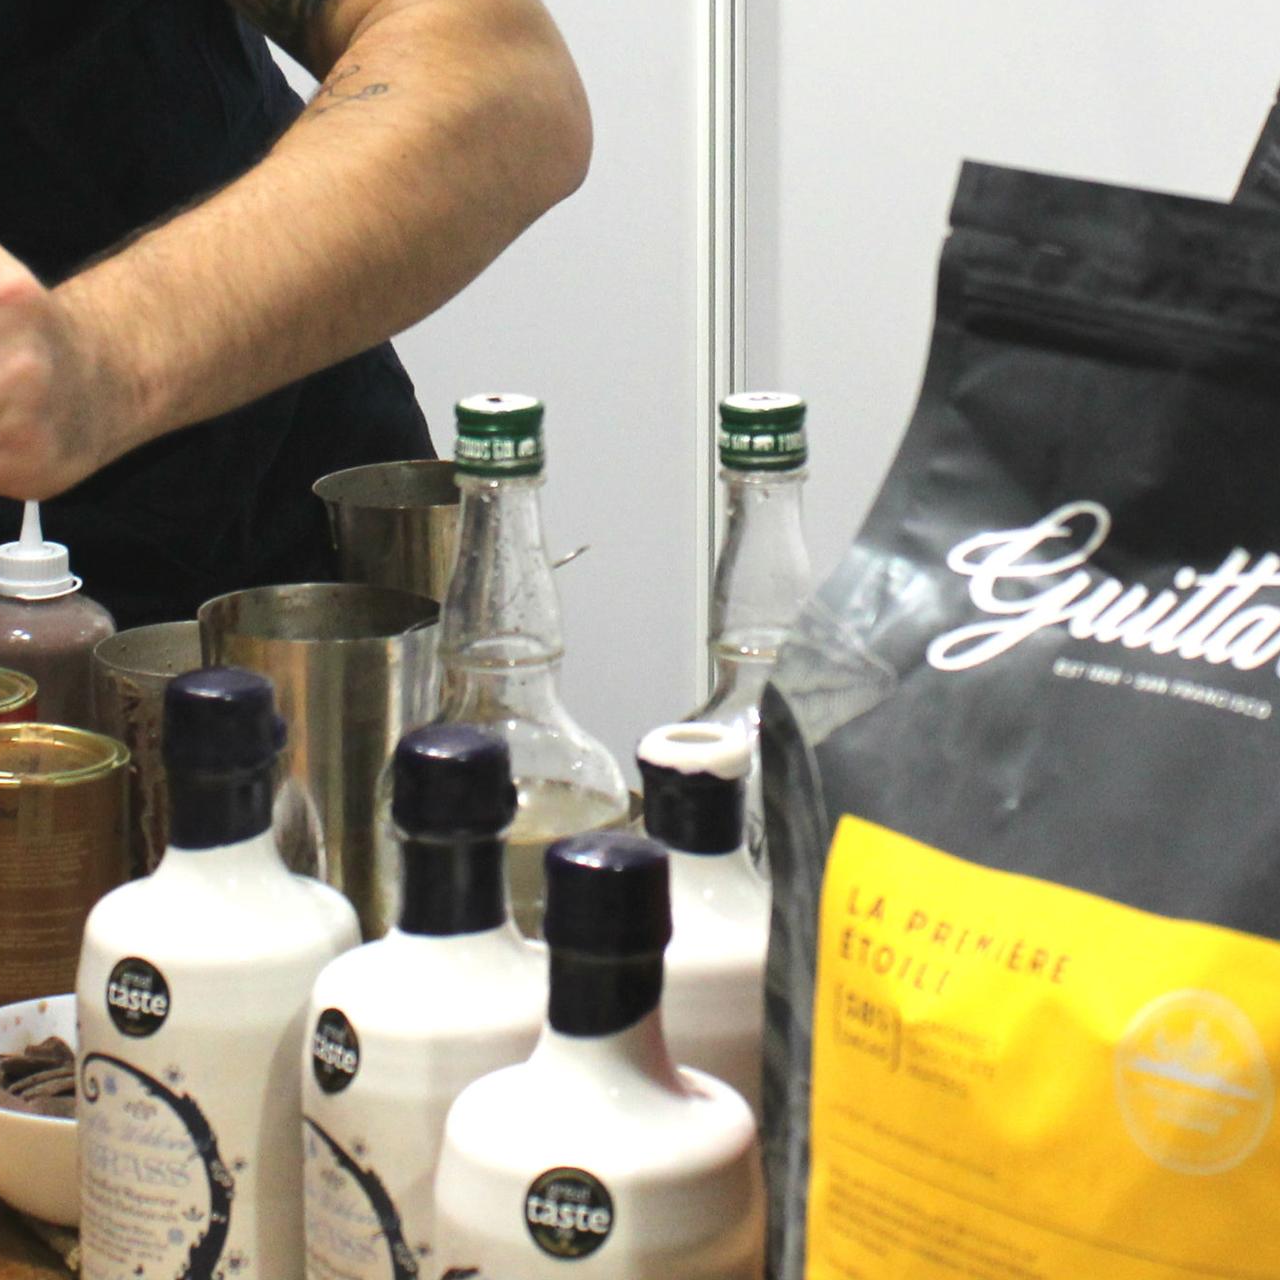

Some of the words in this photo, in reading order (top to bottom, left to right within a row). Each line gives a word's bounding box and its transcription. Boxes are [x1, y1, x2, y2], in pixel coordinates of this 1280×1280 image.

[846, 886, 886, 923] LA
[109, 982, 167, 1017] taste
[312, 1033, 357, 1073] taste
[527, 1195, 610, 1235] taste
